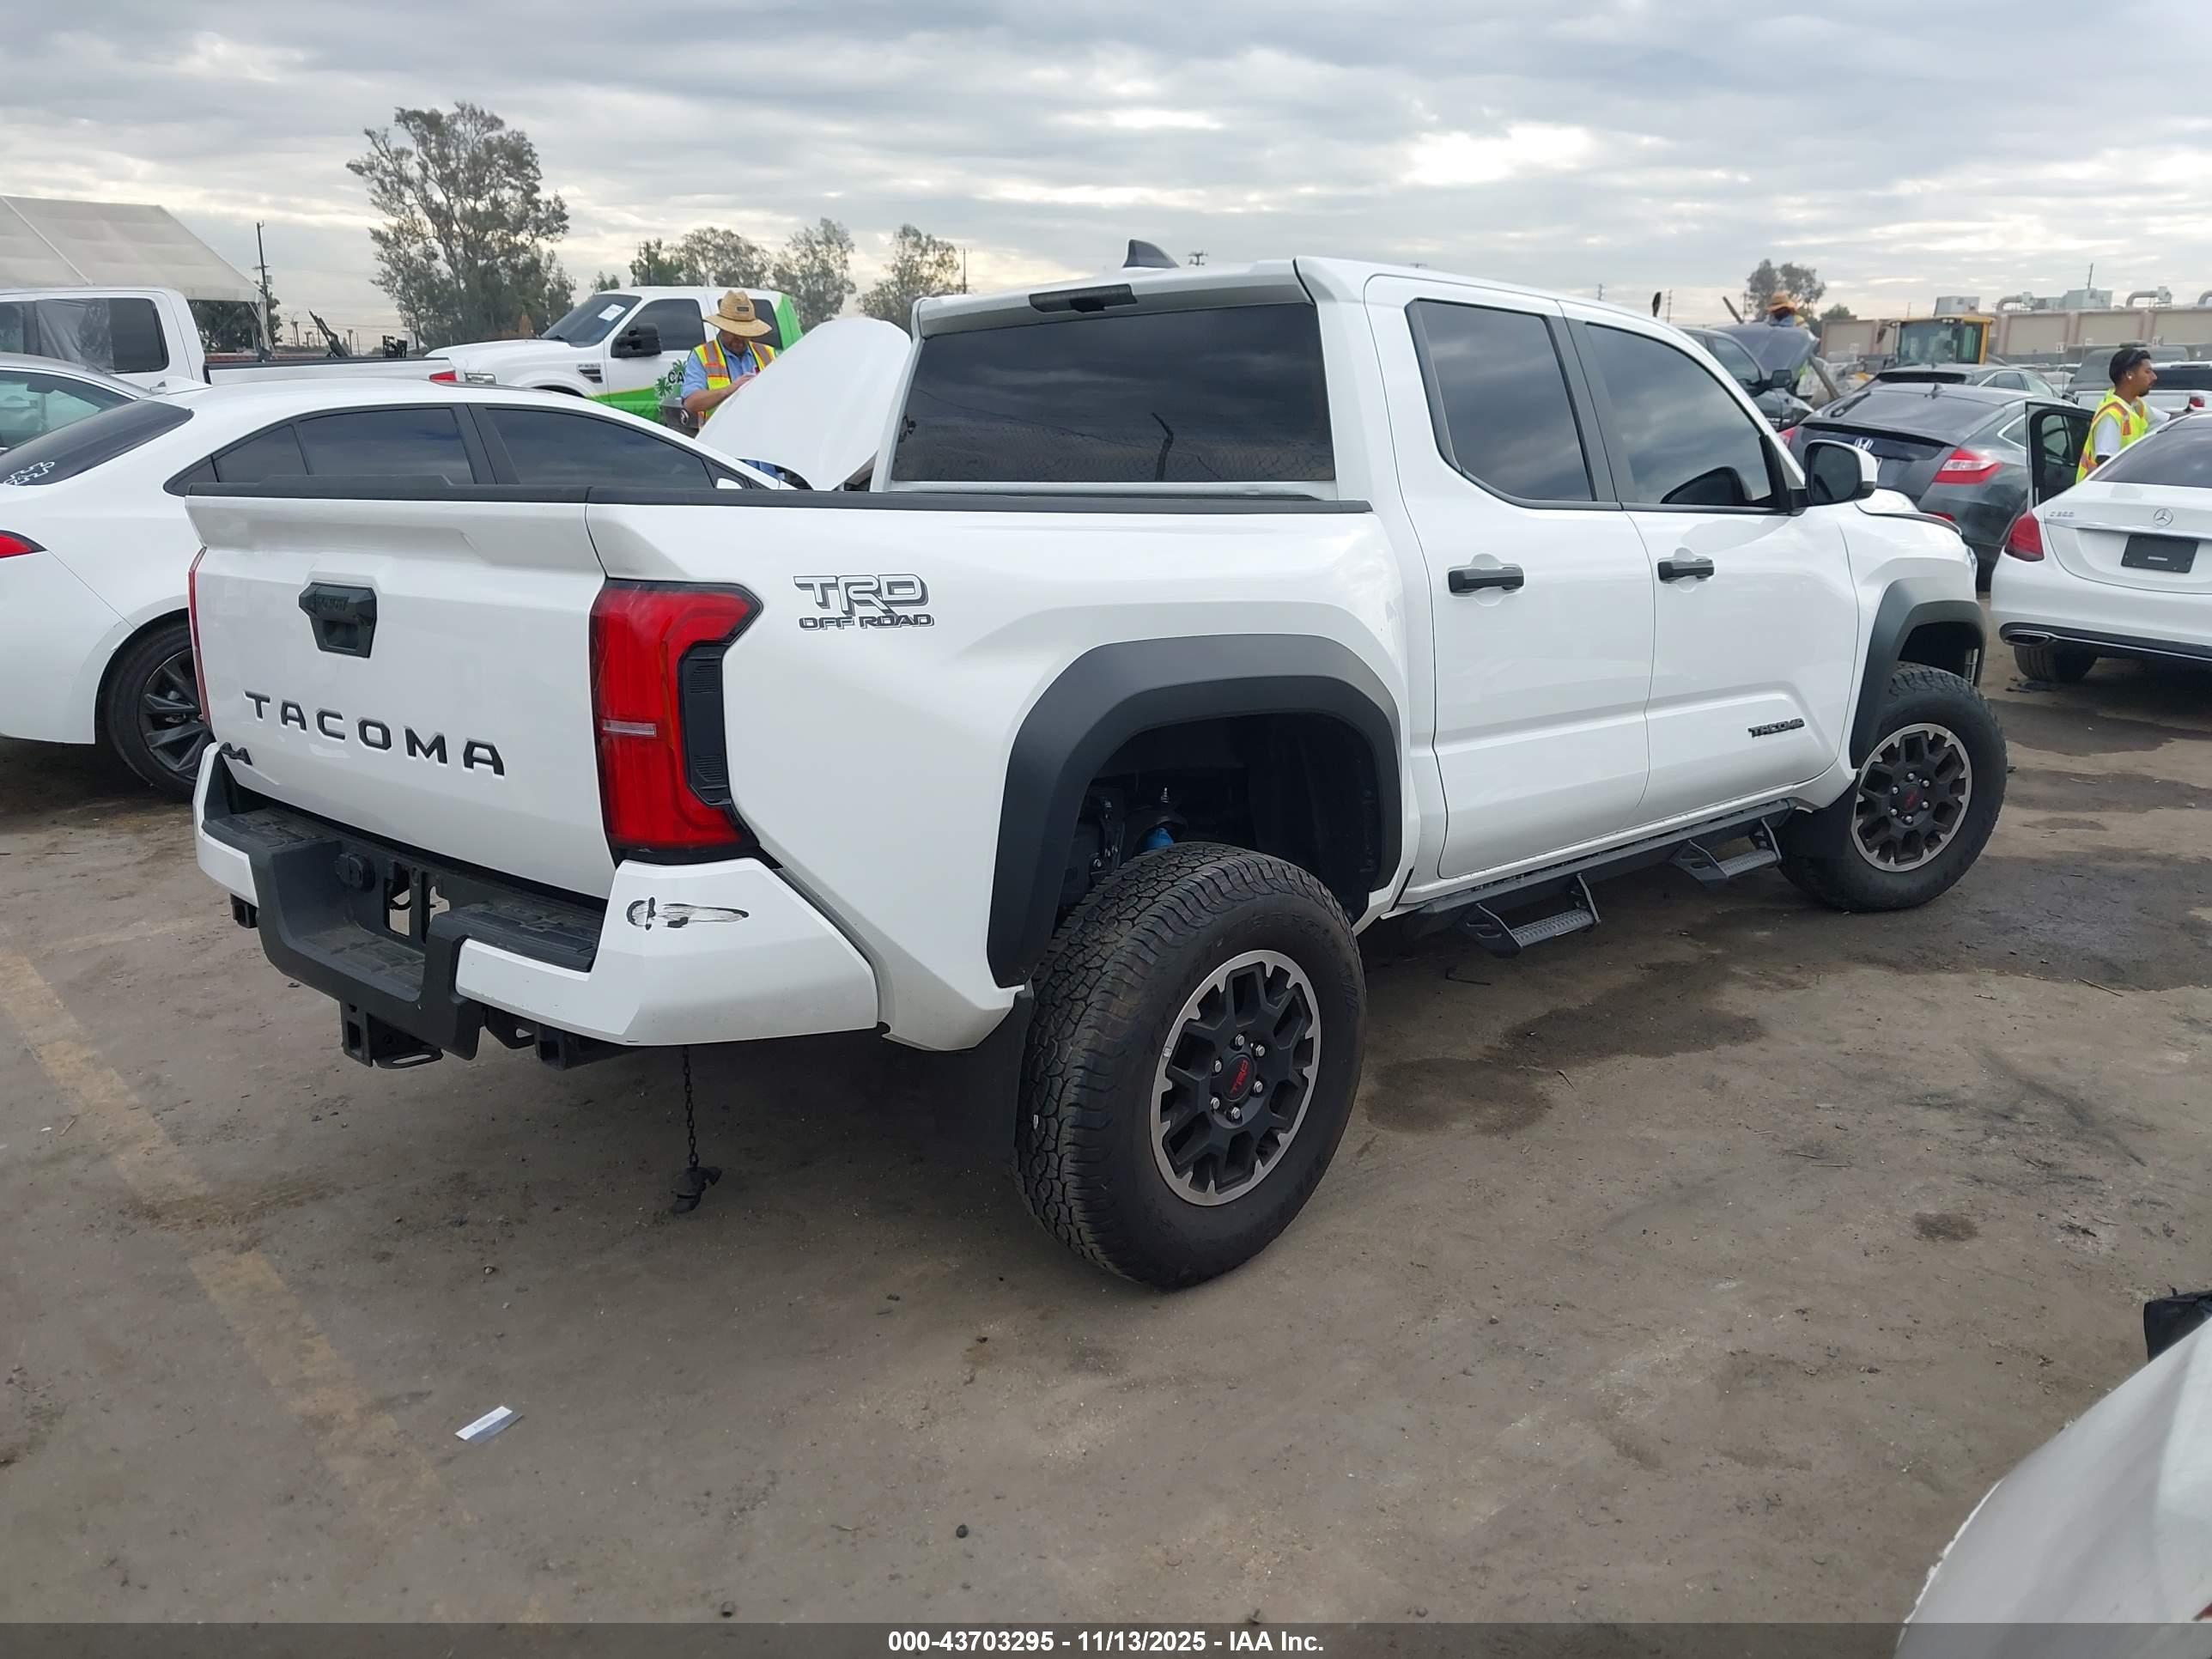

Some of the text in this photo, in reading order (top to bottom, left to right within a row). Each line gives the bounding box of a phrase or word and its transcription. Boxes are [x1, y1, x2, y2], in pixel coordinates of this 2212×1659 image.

[793, 574, 930, 617] TRD
[799, 613, 935, 630] OFF ROAD
[243, 690, 506, 776] TACOMA
[1747, 718, 1805, 738] TACOMA
